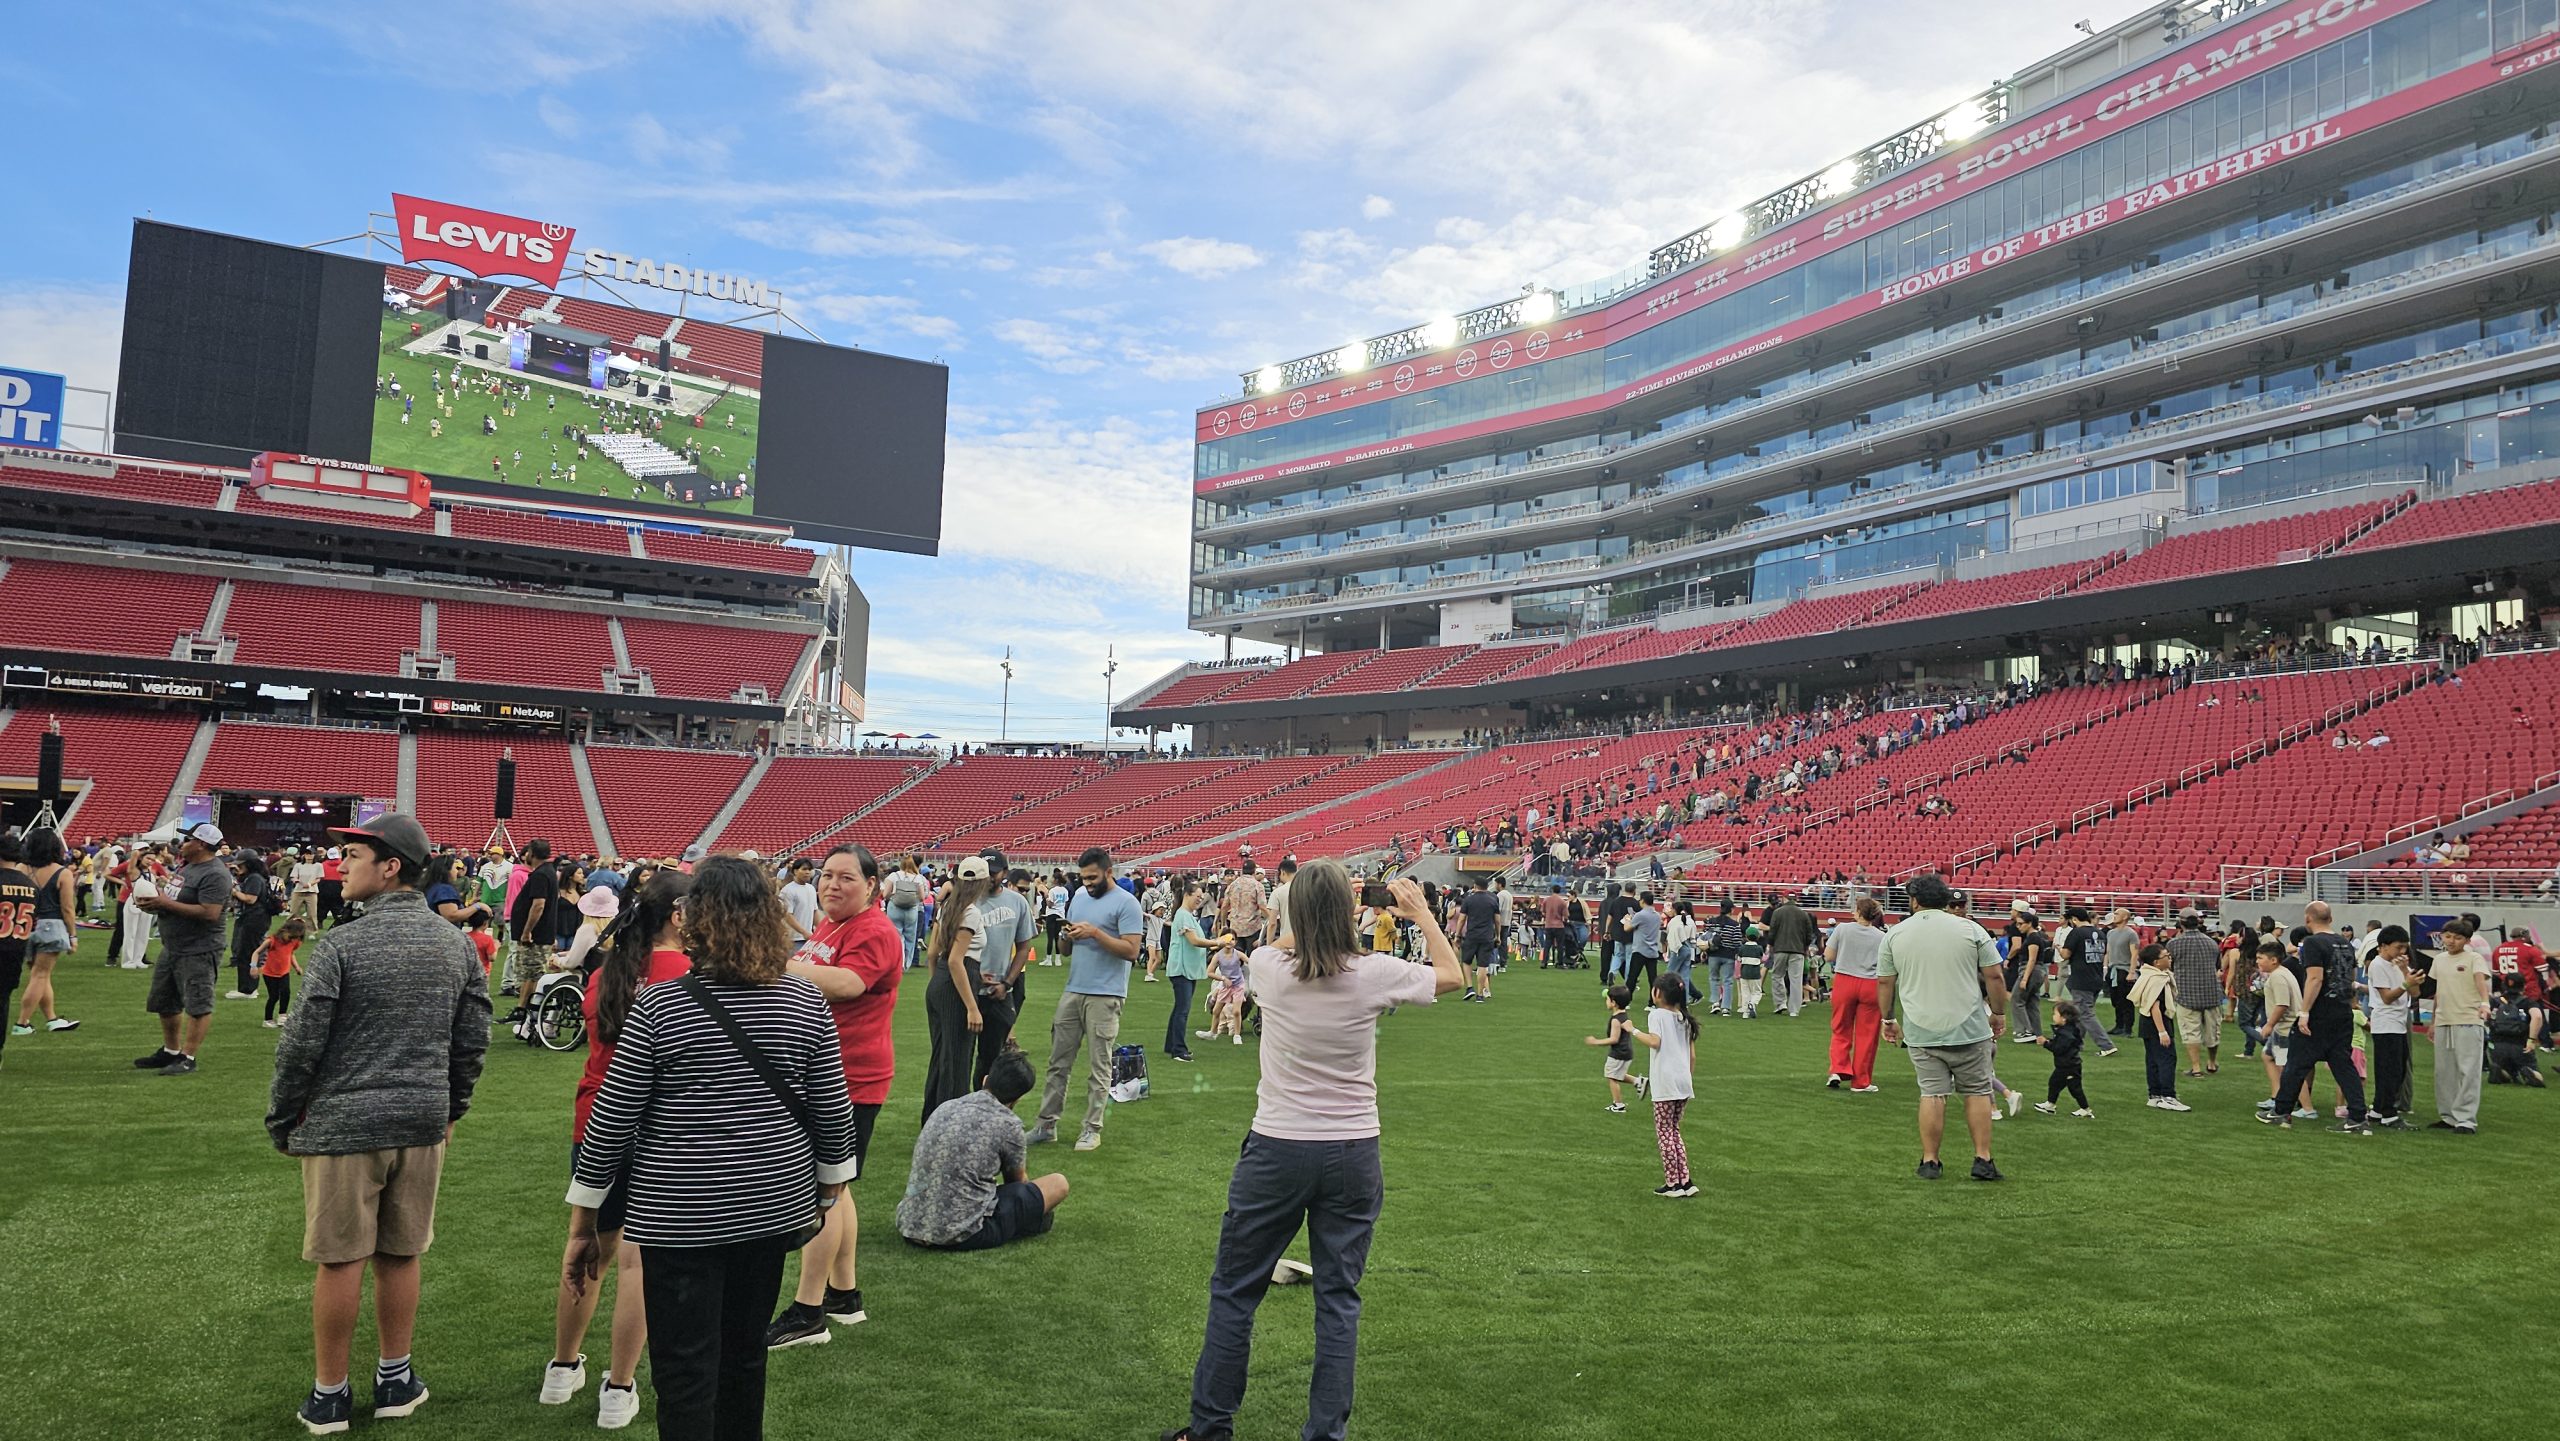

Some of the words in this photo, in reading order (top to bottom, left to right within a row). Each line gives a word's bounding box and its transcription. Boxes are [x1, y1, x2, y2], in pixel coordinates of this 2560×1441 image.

[1823, 172, 1945, 241] SUPER
[1957, 114, 2086, 184] BOWL
[2096, 0, 2378, 121] CHAMPIO
[1880, 256, 1971, 305] HOME
[1981, 236, 2024, 266] OF
[2034, 205, 2108, 247] THE
[2123, 121, 2341, 215] FAITHFUL
[584, 247, 769, 308] STADIUM
[1646, 289, 1680, 316] XVI
[1625, 380, 1664, 400] 22-TIME
[1665, 361, 1713, 386] DIVISION
[1715, 335, 1783, 366] CHAMPIONS
[340, 461, 384, 474] STADIUM
[1286, 460, 1330, 475] MORABITO
[1222, 474, 1264, 488] MORABITO
[65, 678, 91, 687] DELTA
[93, 680, 128, 690] DENTAL
[142, 681, 203, 697] verizon
[434, 702, 449, 711] us
[451, 701, 482, 713] bank
[513, 706, 554, 719] NetApp
[2451, 874, 2468, 883] 142
[2, 884, 35, 898] KITTLE
[2027, 894, 2039, 902] 141
[0, 901, 36, 940] 85
[2499, 955, 2519, 974] 85
